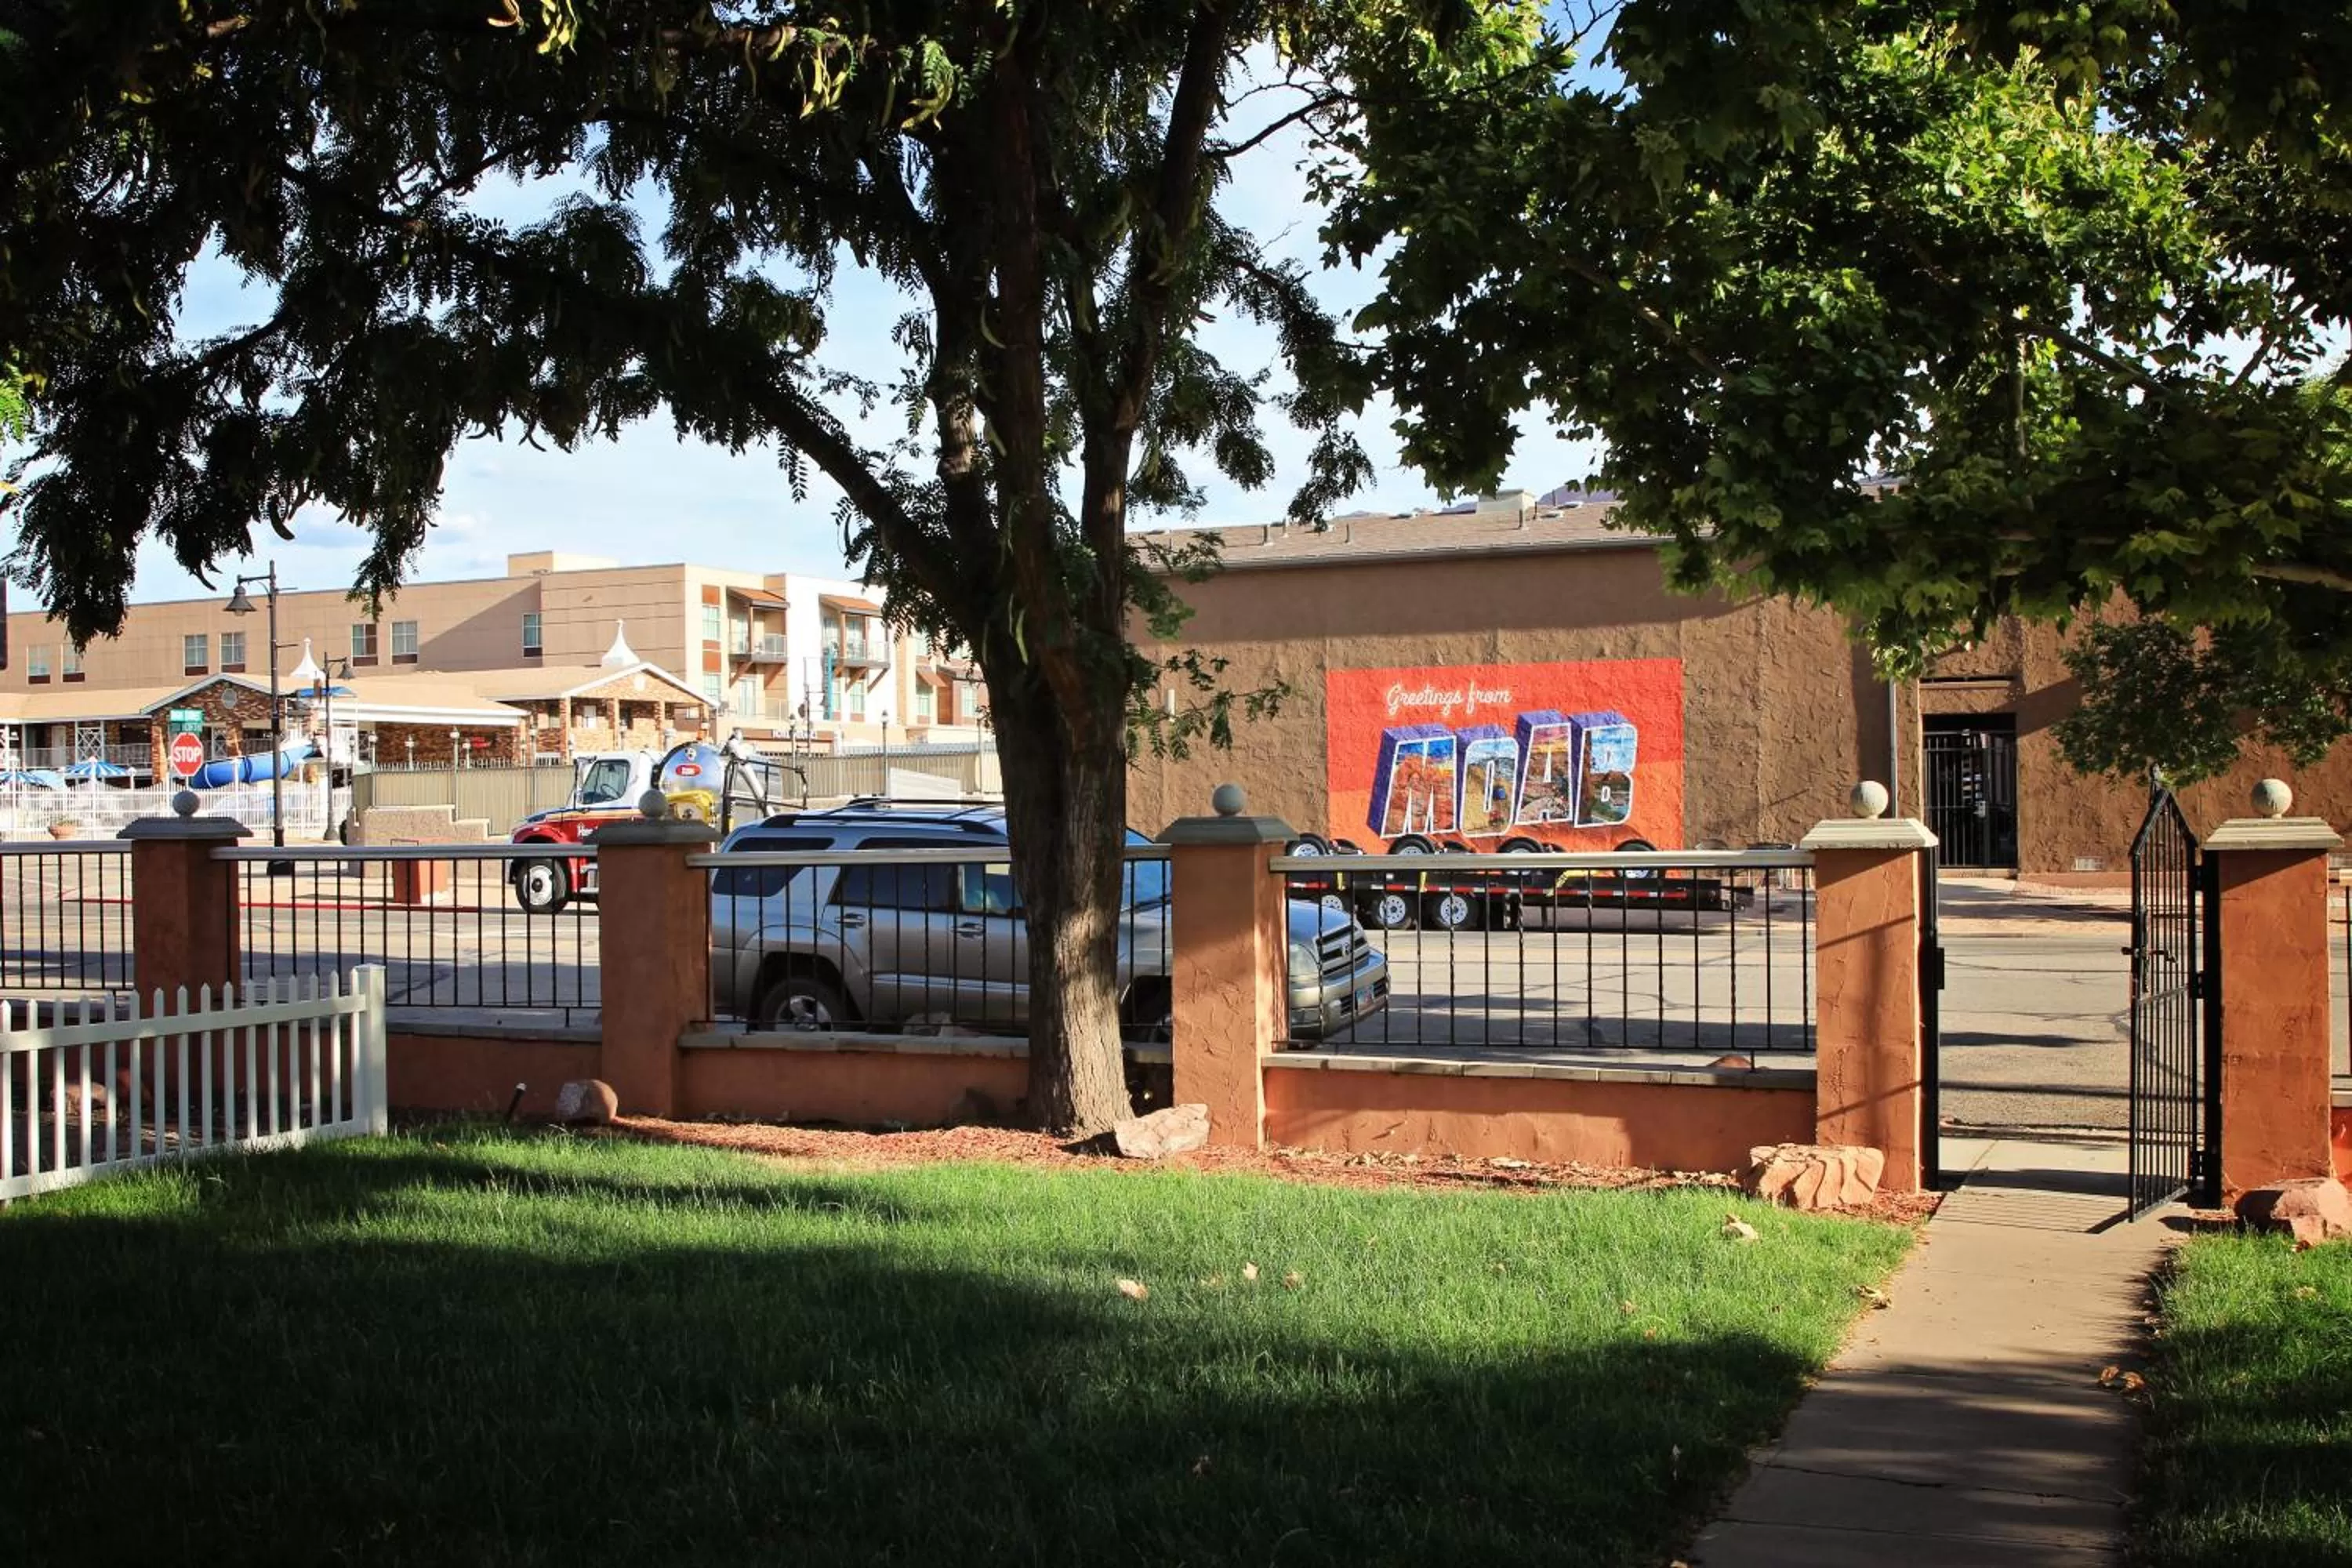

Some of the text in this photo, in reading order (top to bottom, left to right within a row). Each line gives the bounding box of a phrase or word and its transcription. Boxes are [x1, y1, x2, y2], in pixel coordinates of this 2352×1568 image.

[1386, 681, 1512, 717] Greetings from
[173, 746, 201, 763] STOP
[1369, 710, 1638, 839] MOAB
